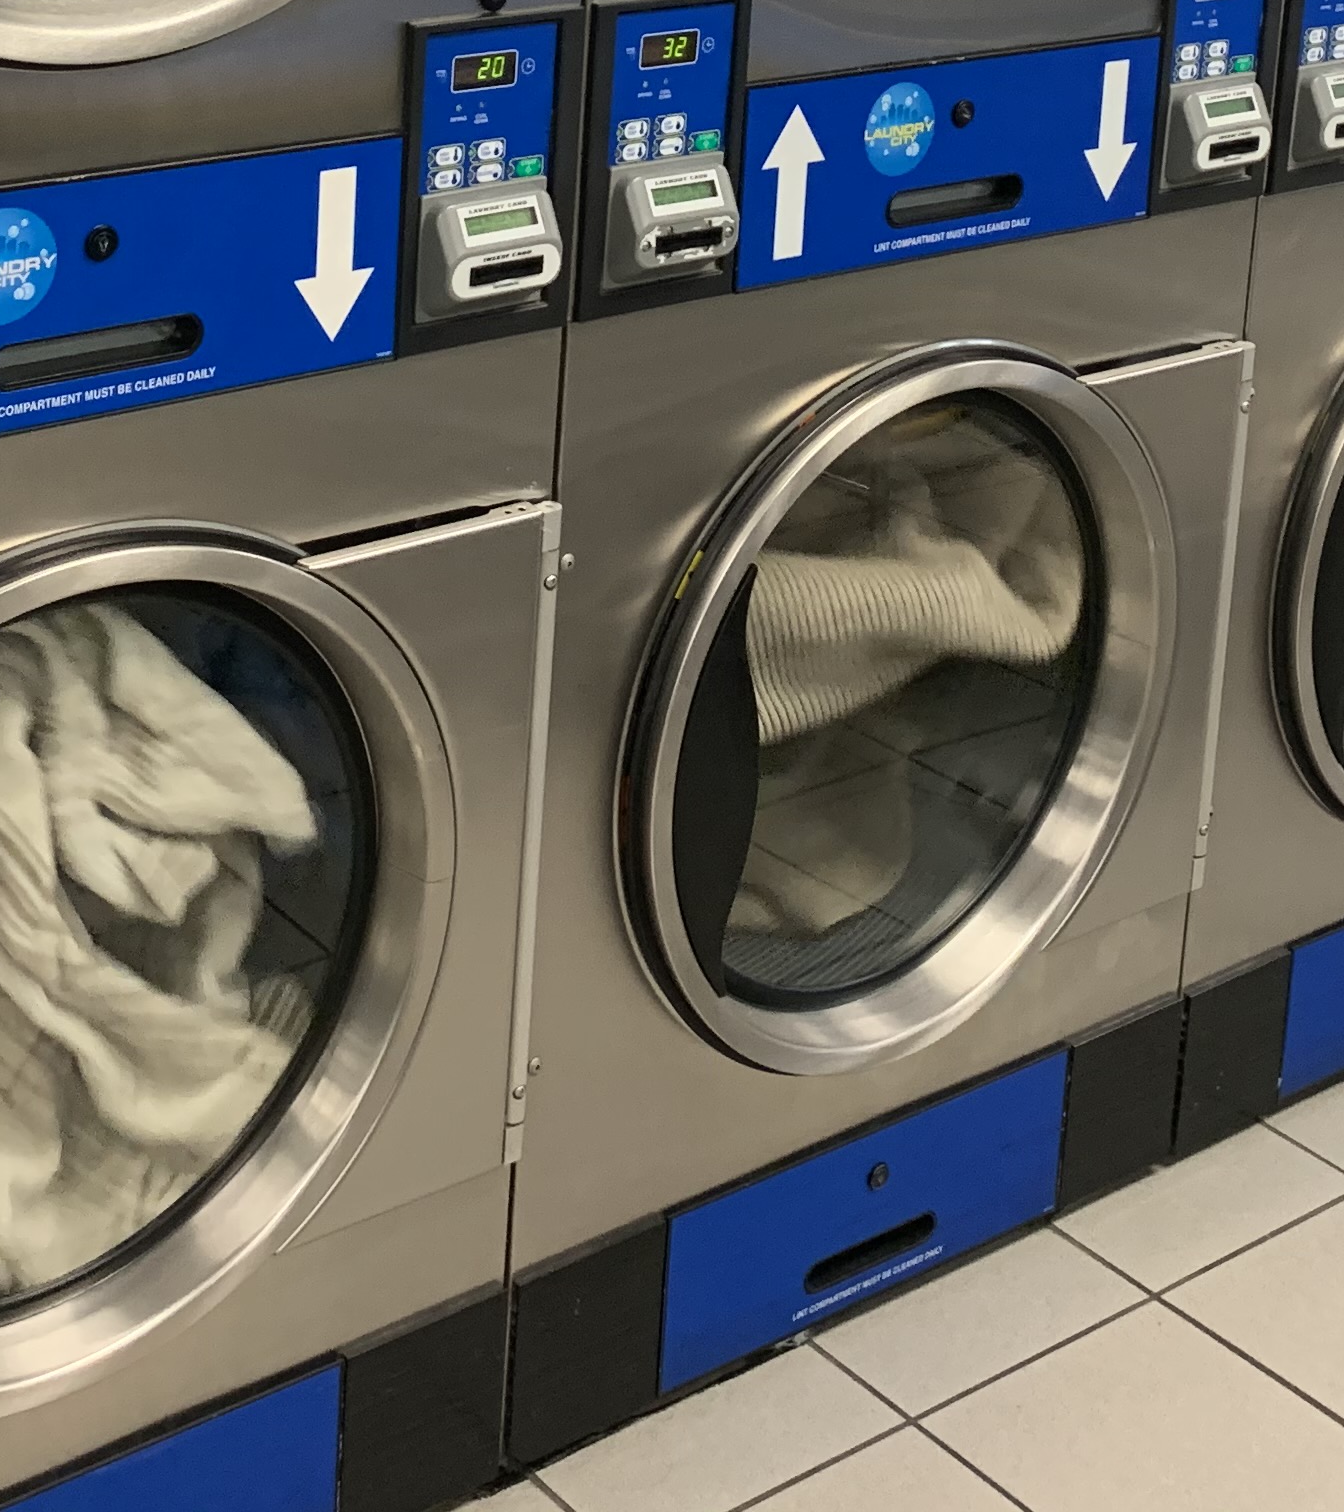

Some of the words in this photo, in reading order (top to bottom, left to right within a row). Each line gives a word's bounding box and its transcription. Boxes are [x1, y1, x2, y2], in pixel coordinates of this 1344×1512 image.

[662, 37, 688, 60] 32
[477, 55, 505, 80] 20
[864, 119, 935, 141] LAUNDRY
[890, 133, 918, 147] CITY
[873, 242, 891, 253] LINT
[978, 220, 1010, 235] CLEANED
[1011, 217, 1031, 229] DAILY
[84, 385, 116, 401] MUST
[117, 382, 133, 396] BE
[134, 373, 185, 392] CLEANED
[186, 366, 216, 383] DAILY
